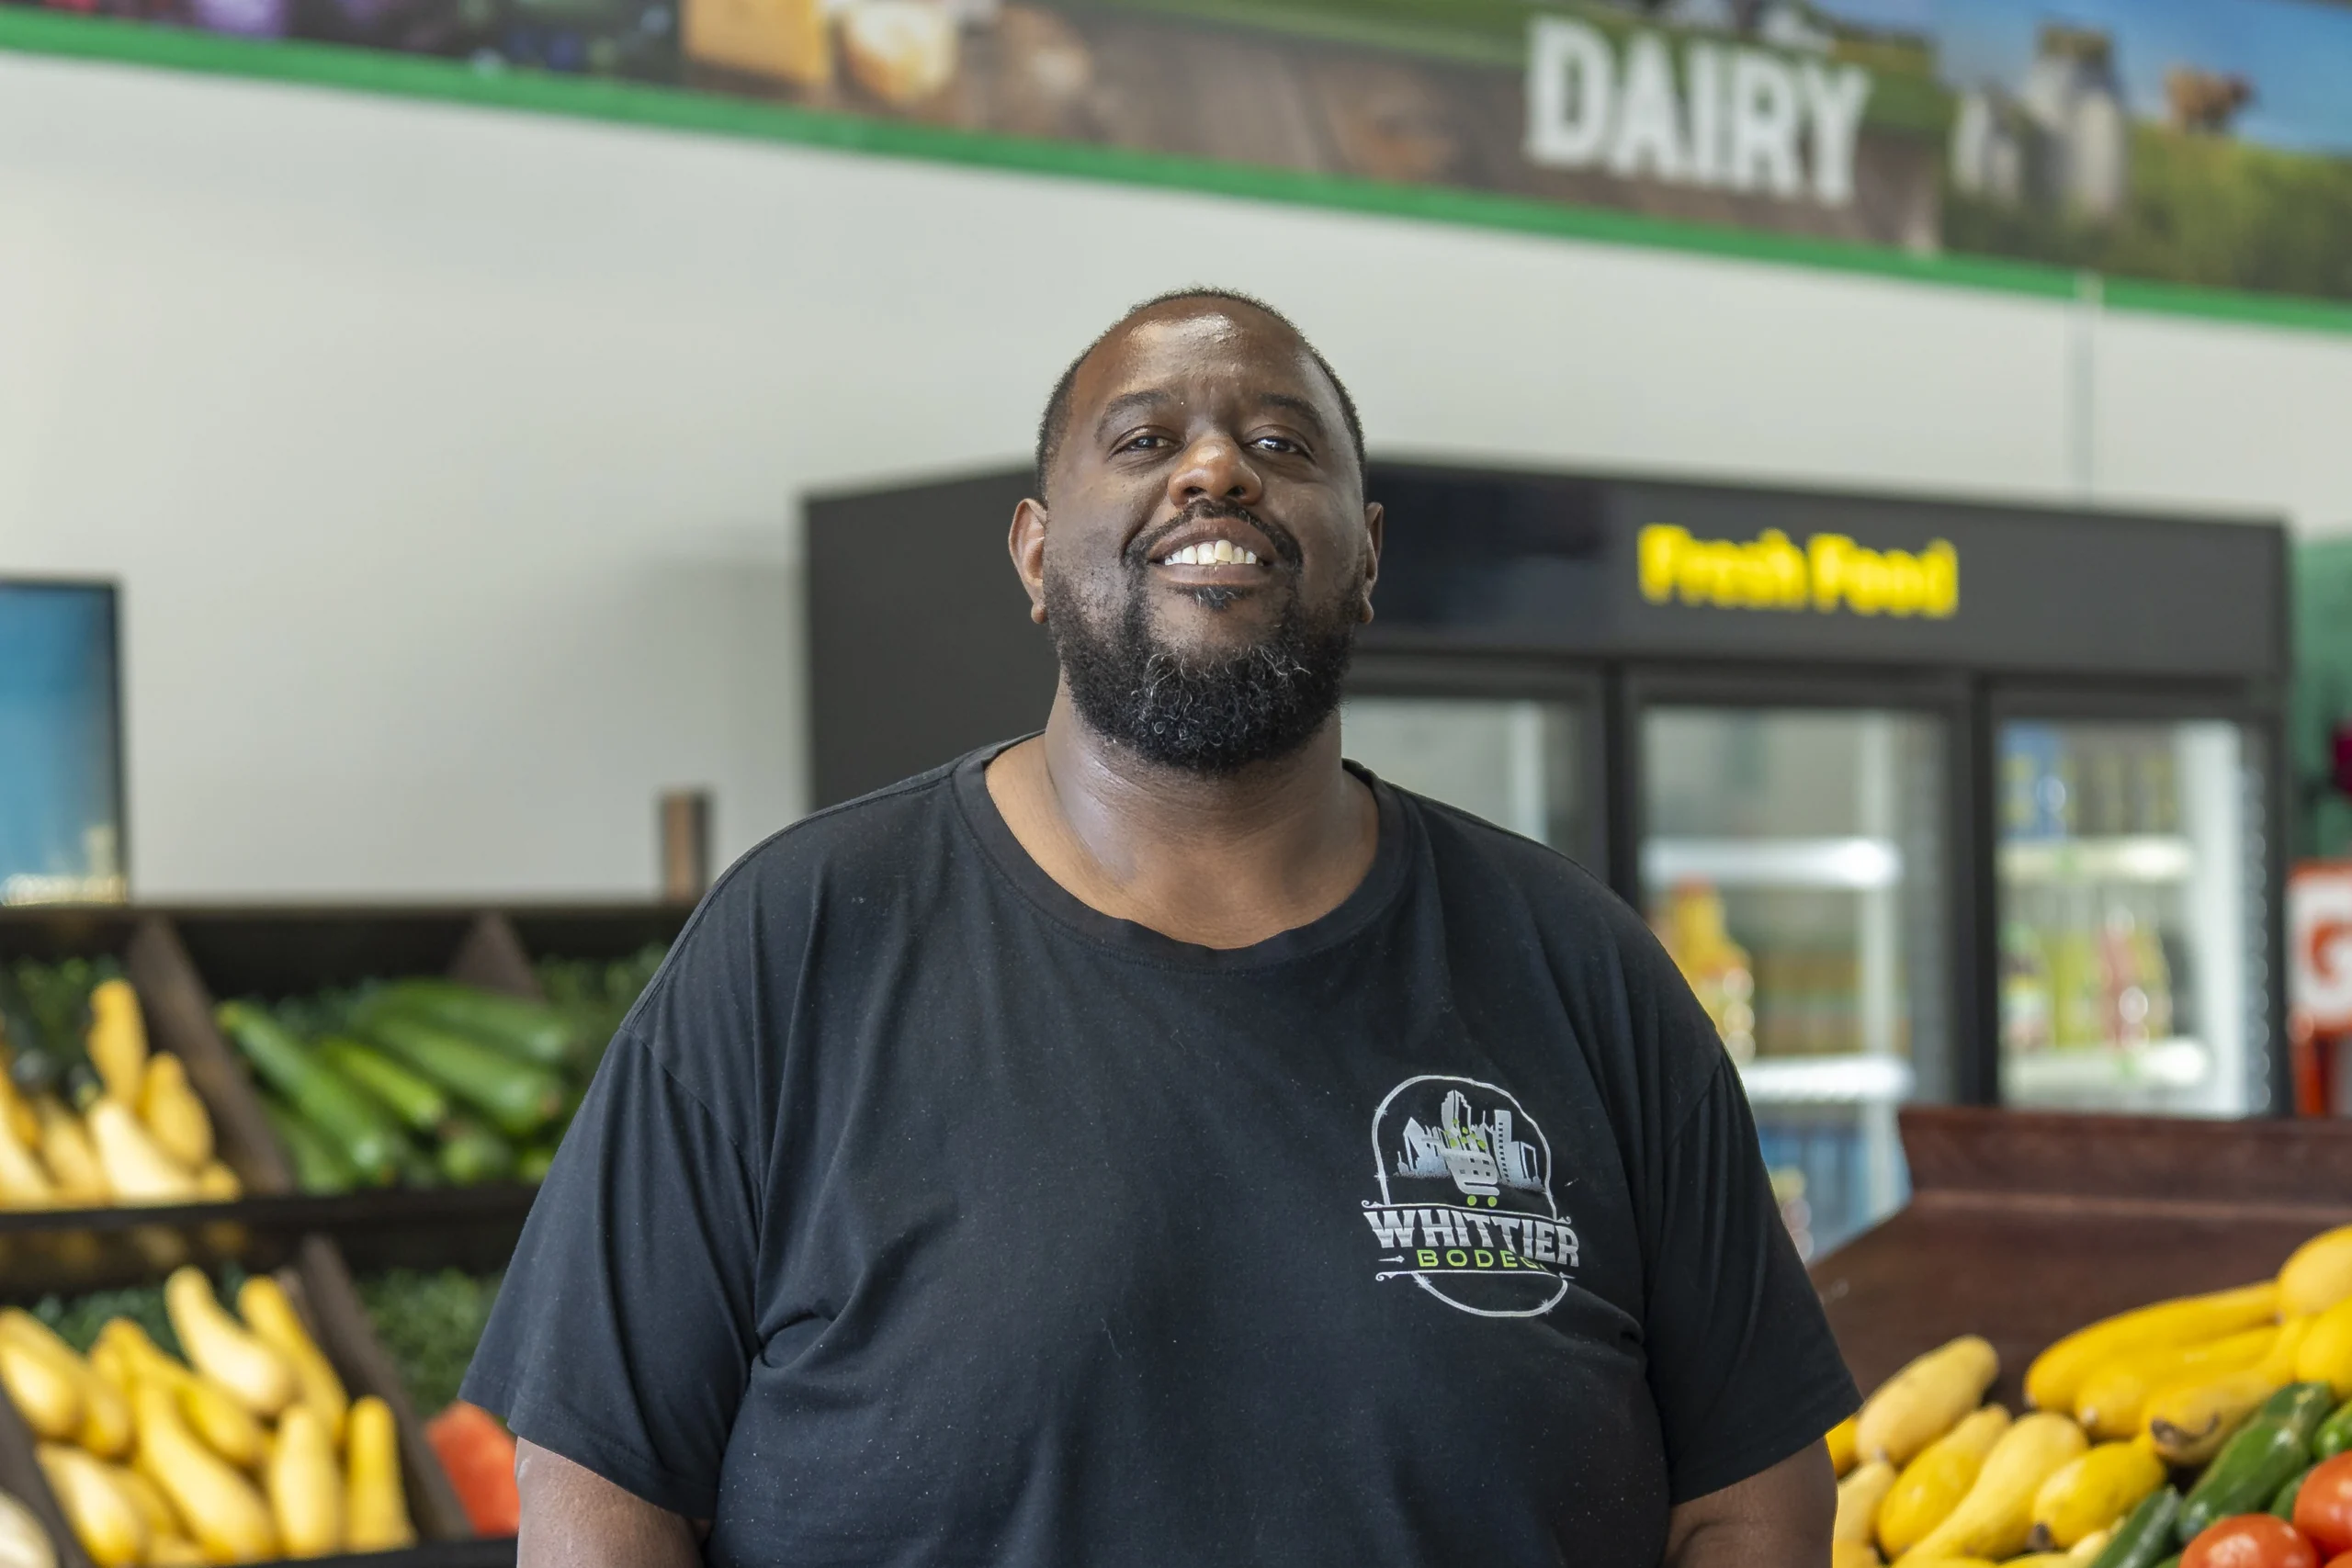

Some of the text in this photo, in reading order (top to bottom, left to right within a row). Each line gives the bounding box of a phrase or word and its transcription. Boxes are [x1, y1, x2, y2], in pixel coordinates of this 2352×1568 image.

[1525, 17, 1870, 206] DAIRY
[1639, 525, 1958, 617] Fresh Food
[1363, 1210, 1578, 1267] WHITTIER
